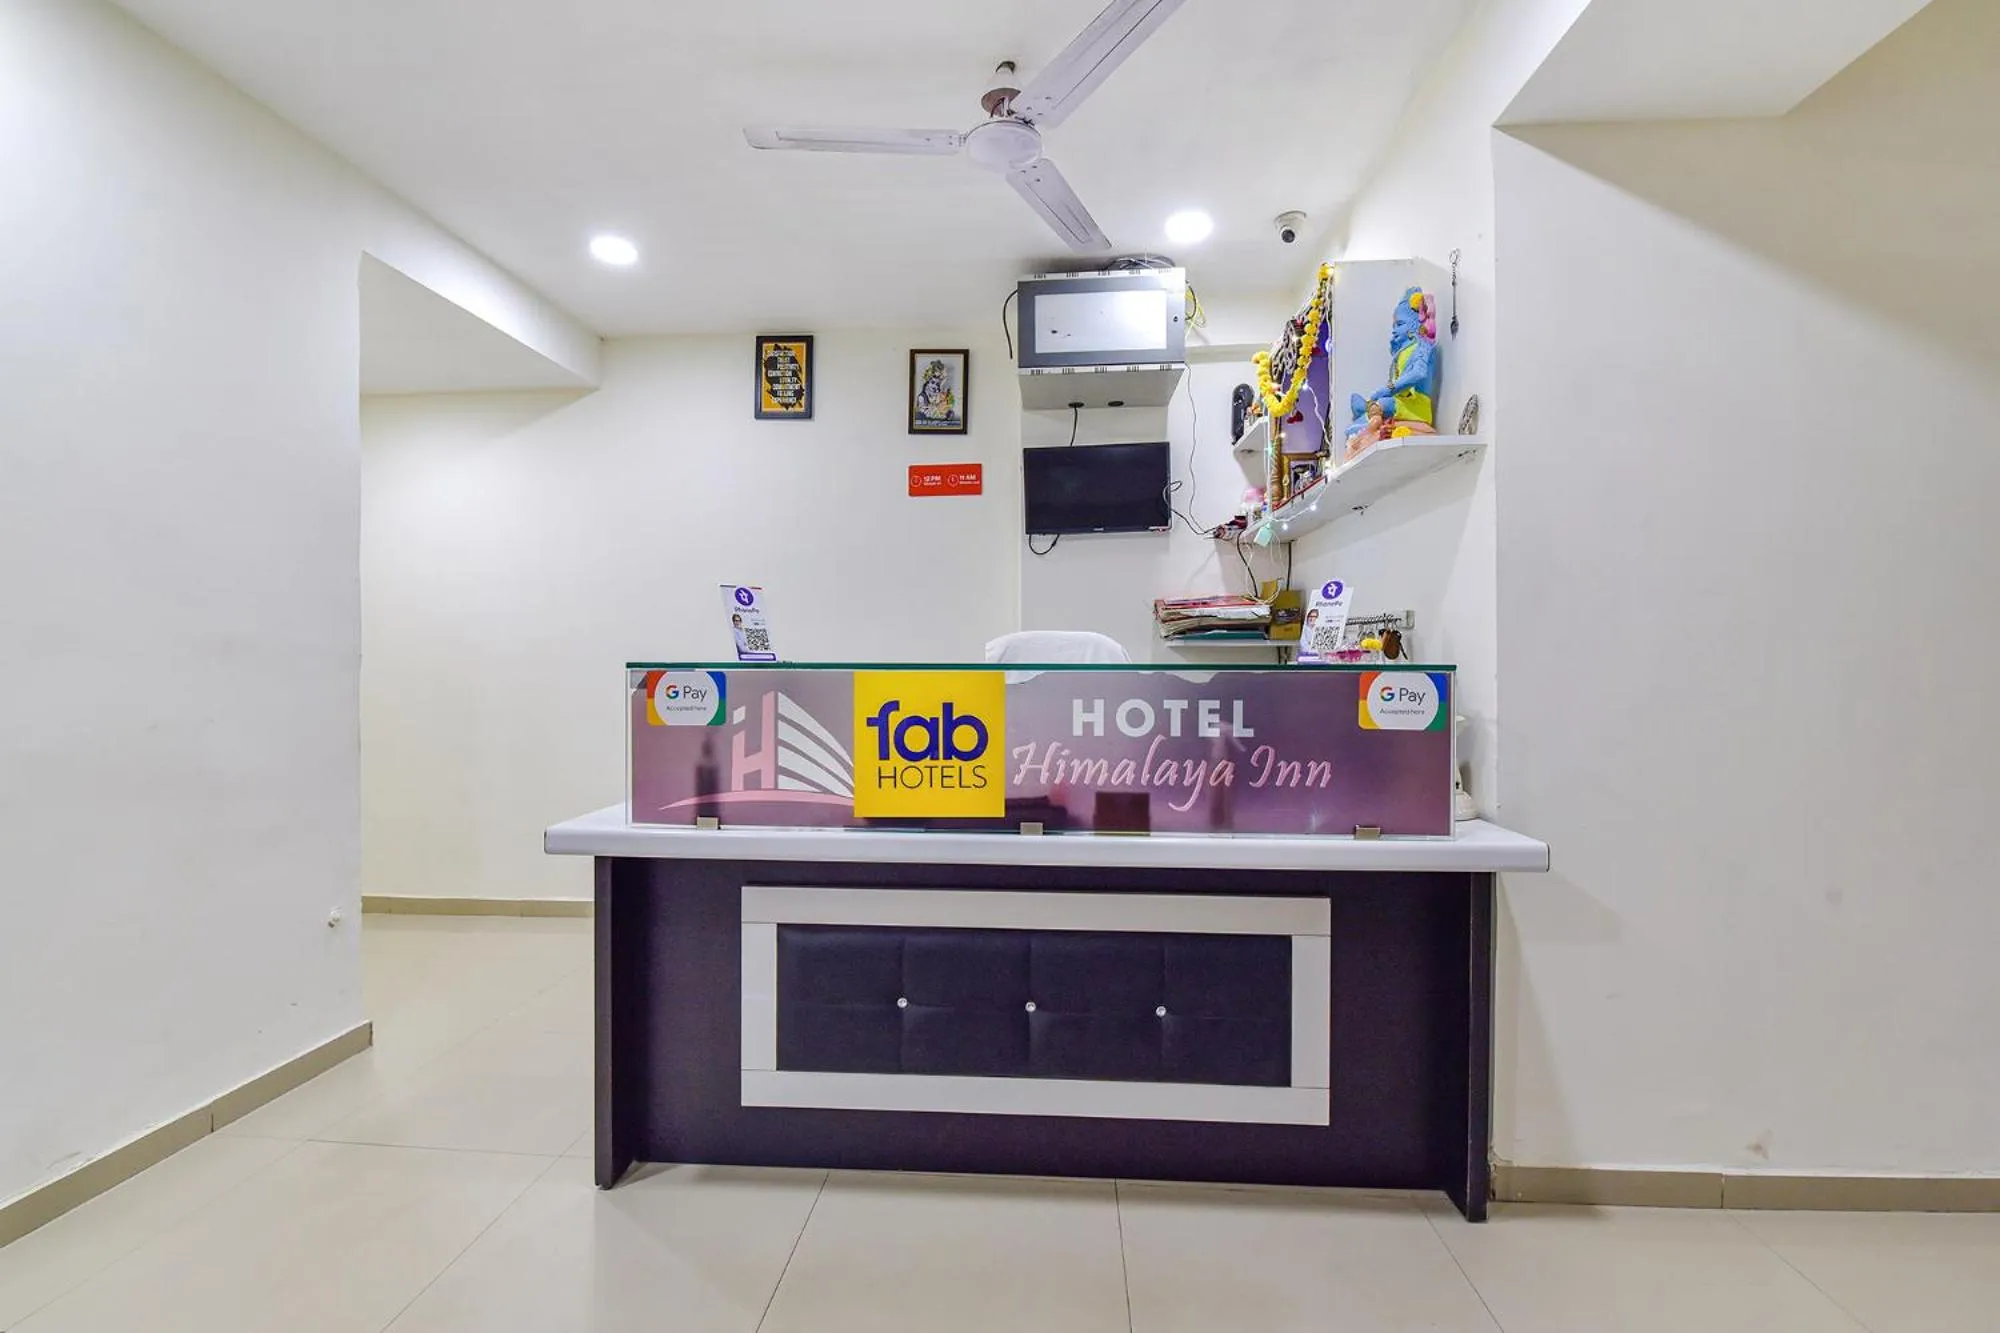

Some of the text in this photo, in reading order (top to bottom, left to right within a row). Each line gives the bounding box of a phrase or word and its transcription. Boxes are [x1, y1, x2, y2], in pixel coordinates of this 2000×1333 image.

[1315, 600, 1344, 608] PhonePe
[683, 684, 707, 702] Pay
[1399, 687, 1426, 705] Pay
[1072, 699, 1255, 738] HOTEL
[866, 700, 989, 762] fab
[878, 765, 988, 789] HOTELS
[1012, 734, 1332, 812] Himalaya Inn
